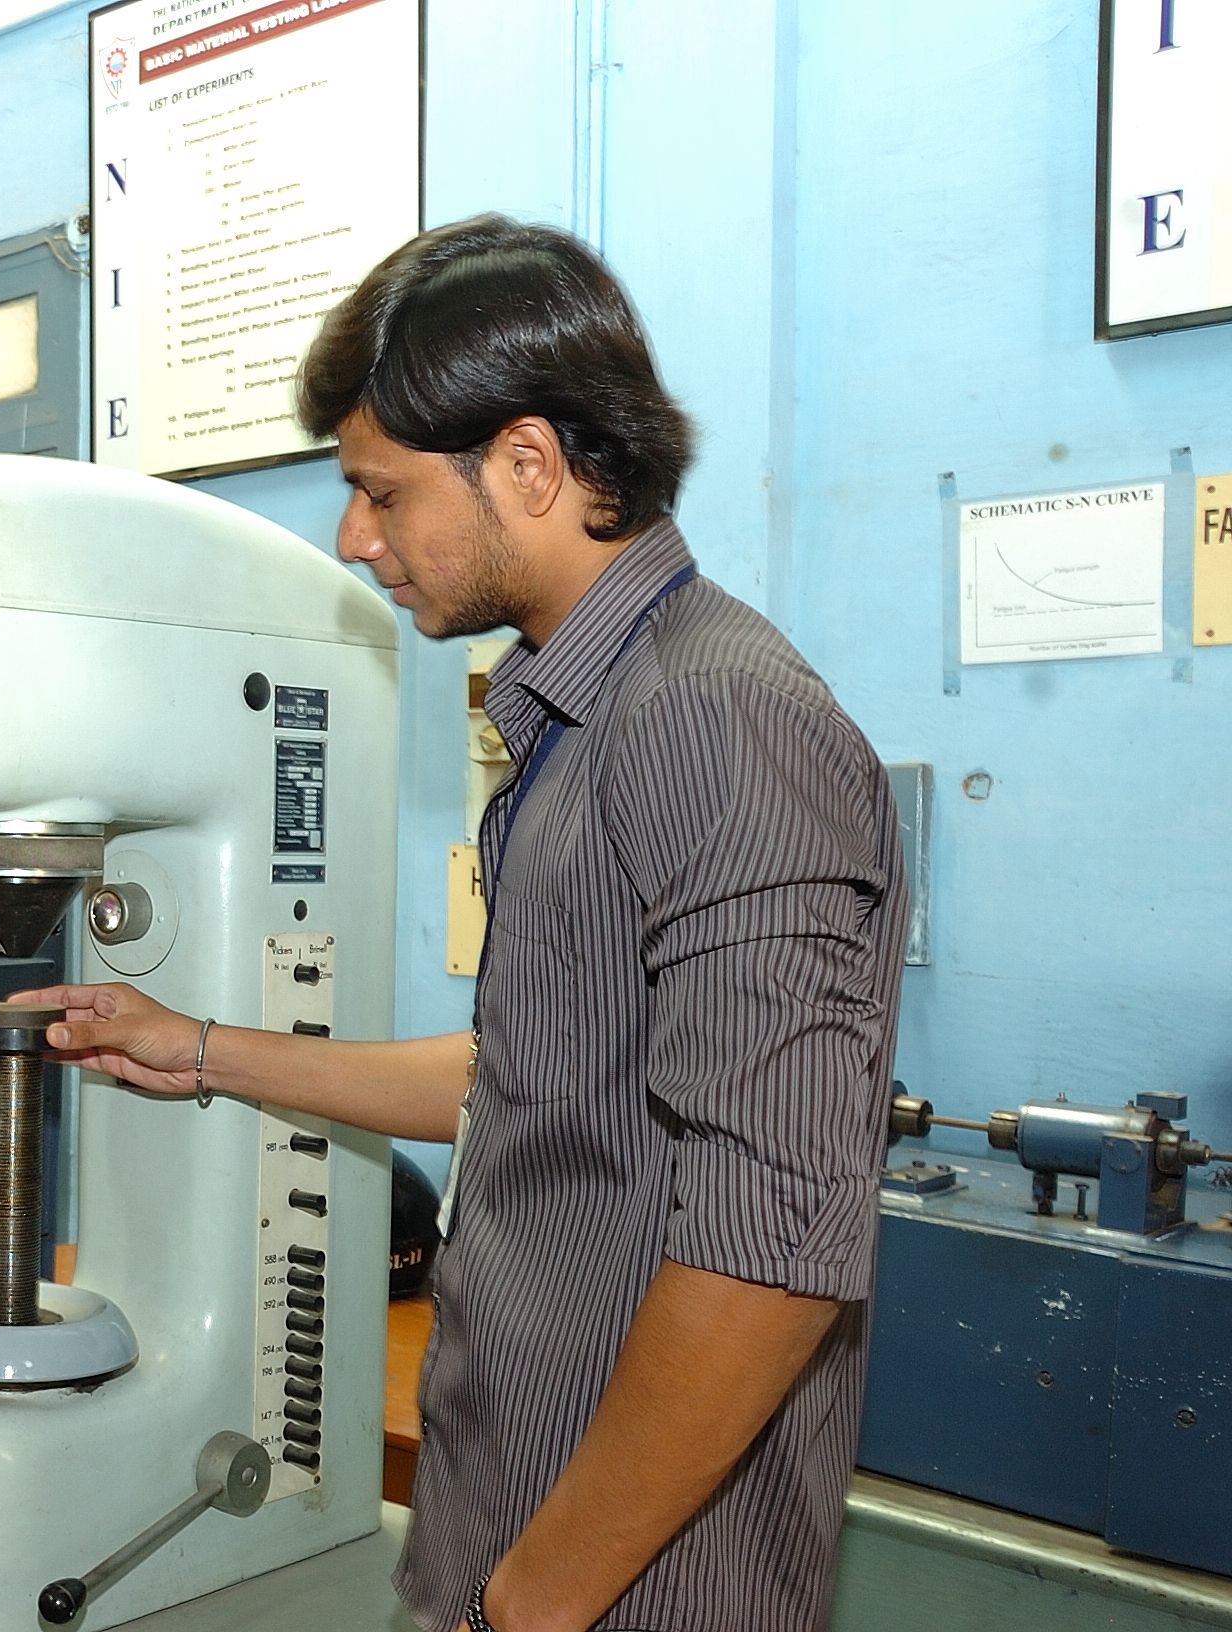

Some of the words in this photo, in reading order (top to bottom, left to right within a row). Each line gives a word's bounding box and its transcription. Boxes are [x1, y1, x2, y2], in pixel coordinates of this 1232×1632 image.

[183, 25, 250, 58] MATERIAL
[251, 3, 311, 35] TESTING
[148, 97, 169, 112] LIST
[170, 91, 184, 105] OF
[186, 67, 255, 100] EXPERIMENTS
[104, 158, 128, 202] N
[1136, 188, 1187, 257] E
[110, 267, 122, 309] I
[106, 397, 129, 440] E
[969, 499, 1062, 520] SCHEMATIC
[1065, 496, 1092, 510] S-N
[1095, 488, 1155, 507] CURVE
